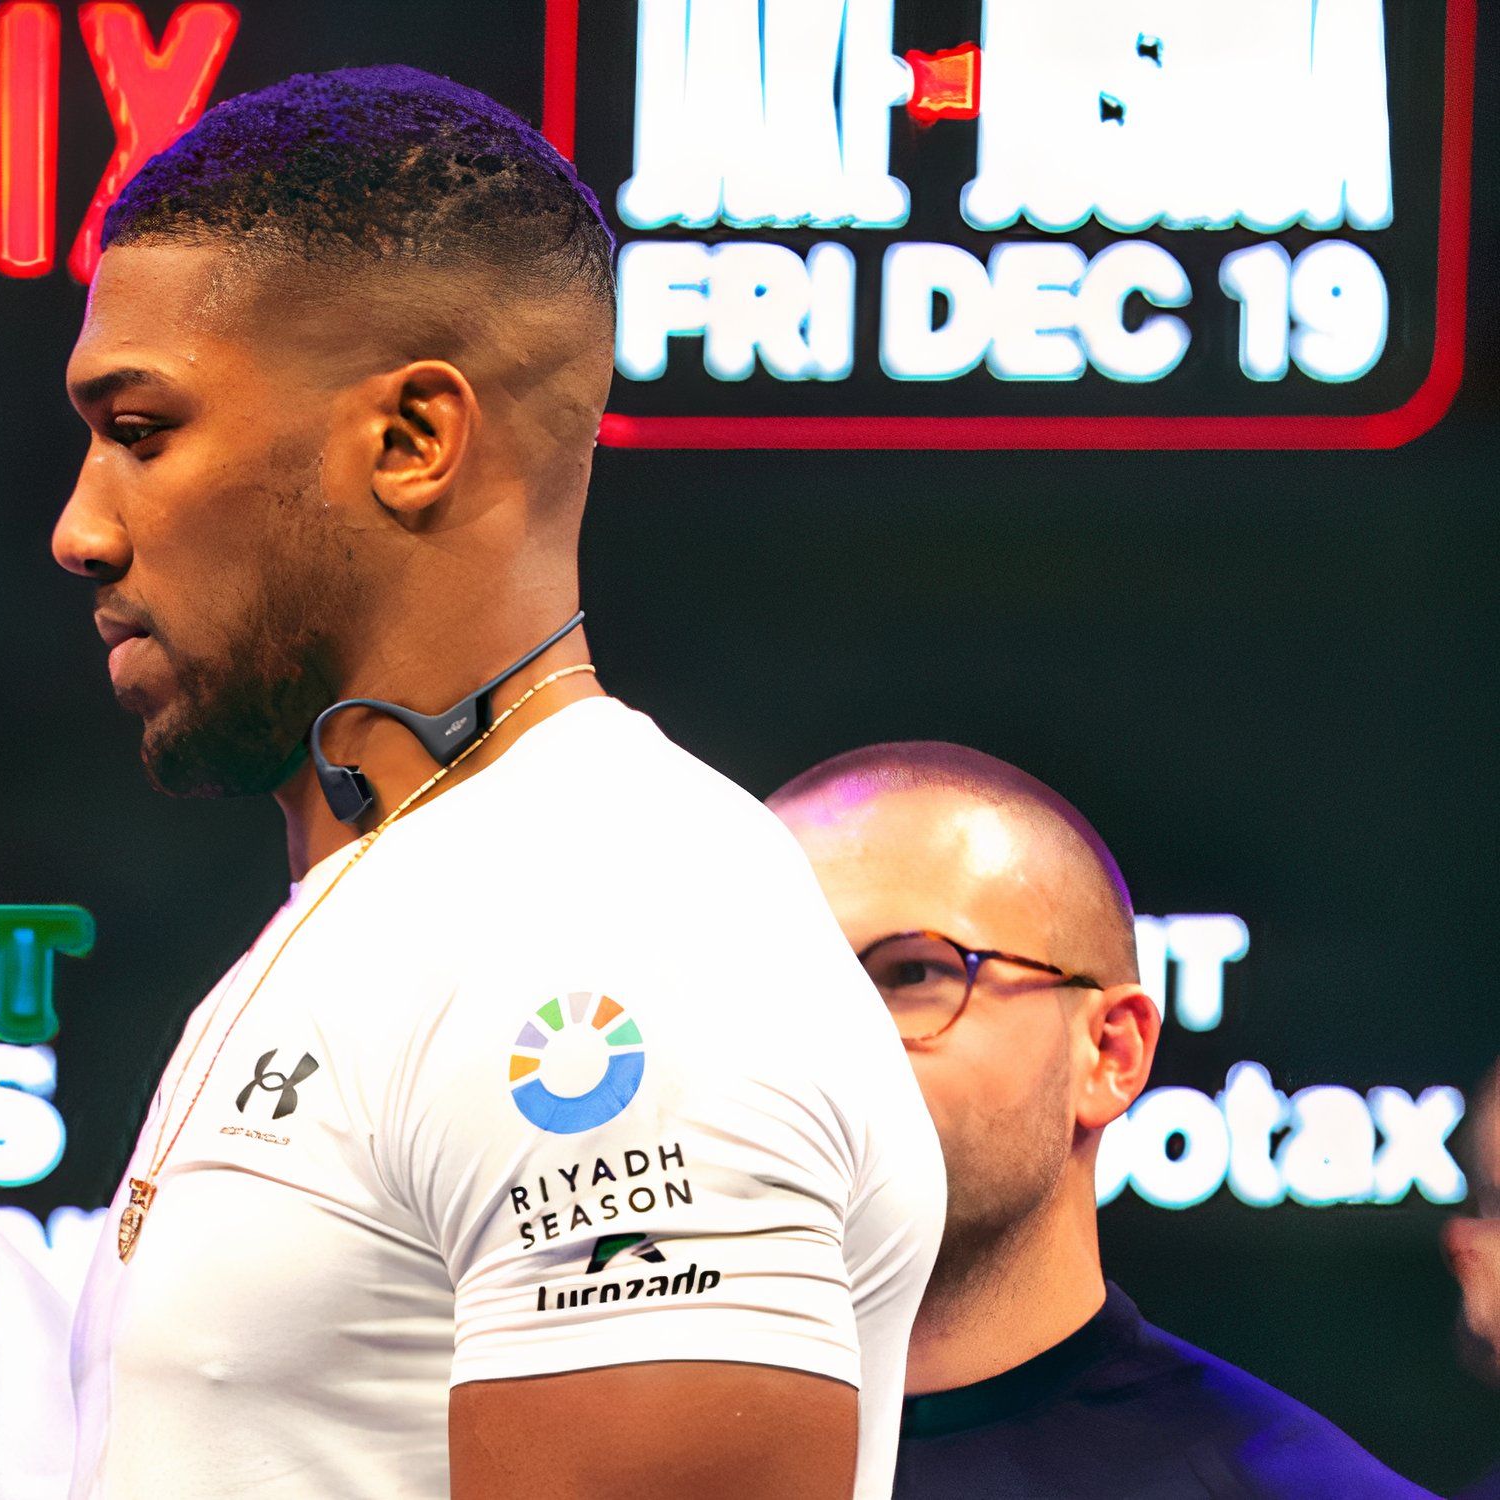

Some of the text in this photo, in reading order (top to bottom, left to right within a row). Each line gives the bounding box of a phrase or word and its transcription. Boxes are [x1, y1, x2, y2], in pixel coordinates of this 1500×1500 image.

[613, 239, 1388, 383] FRI DEC 19
[510, 1142, 685, 1215] RIYADH
[519, 1178, 694, 1250] SEASON
